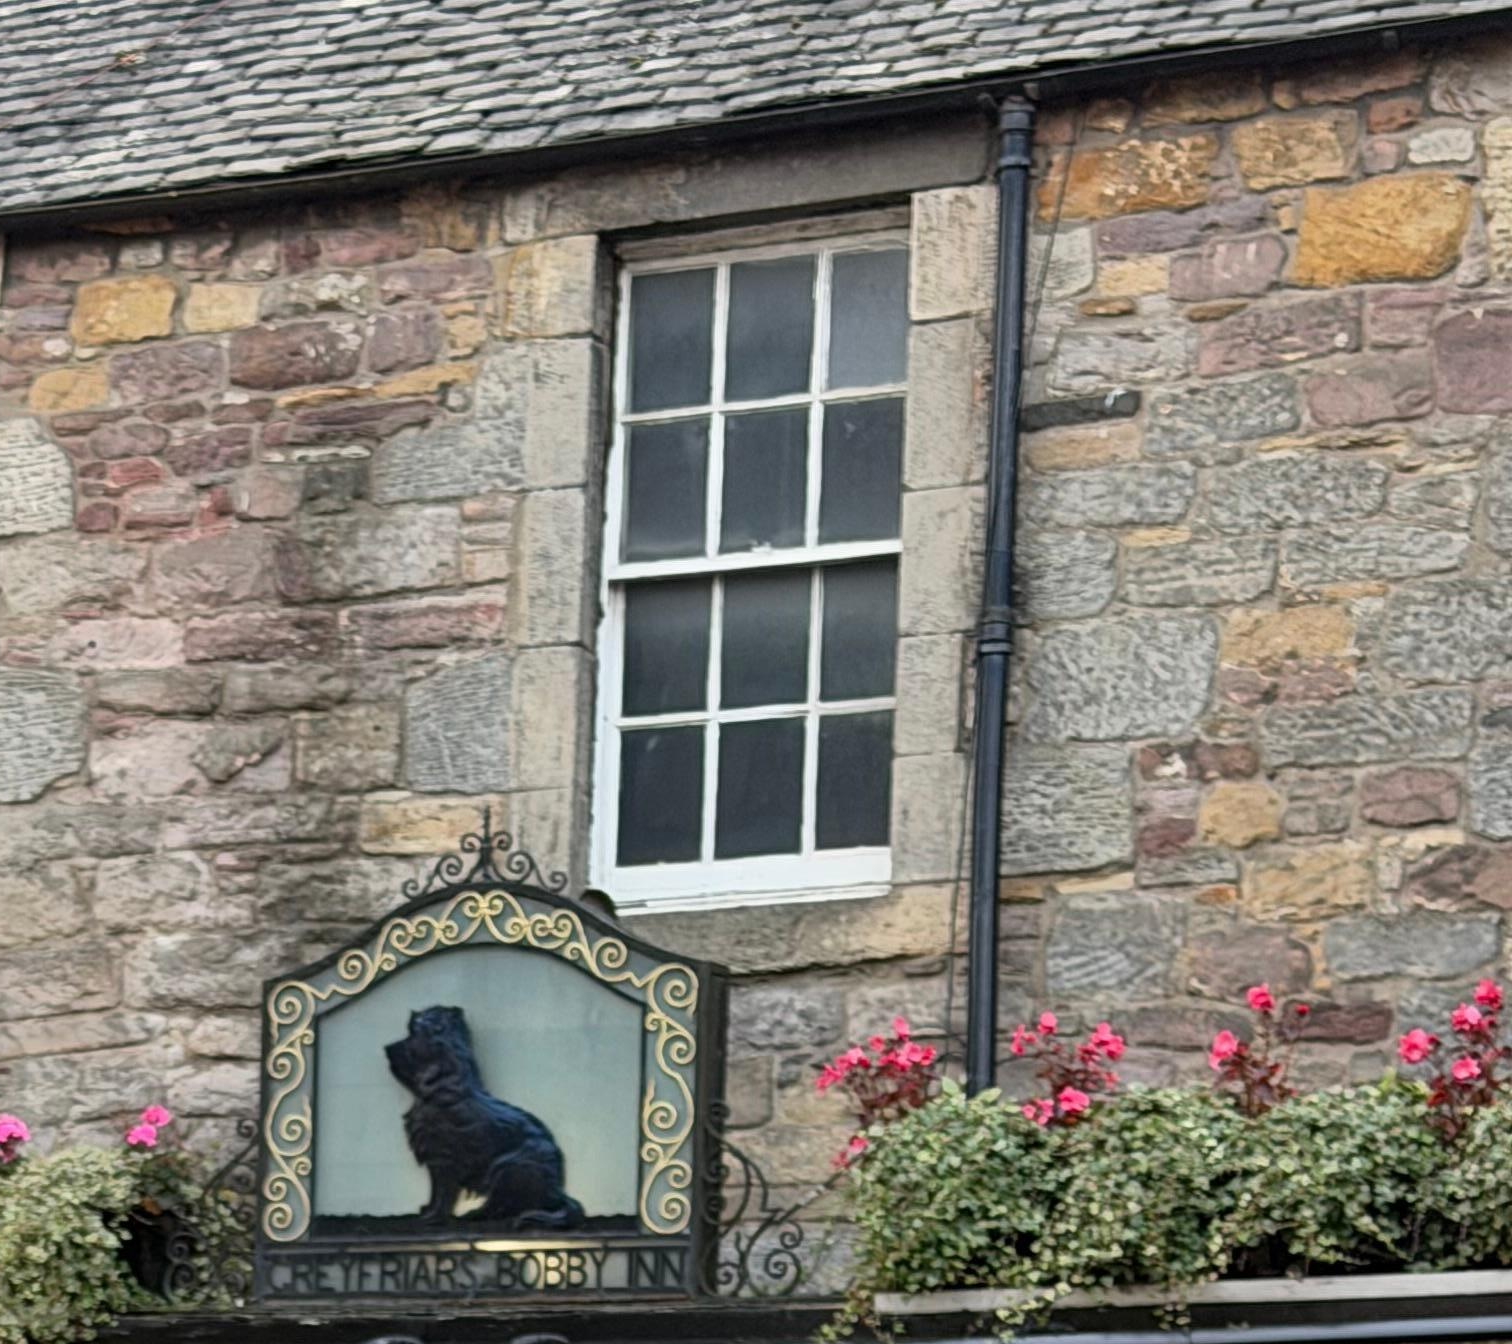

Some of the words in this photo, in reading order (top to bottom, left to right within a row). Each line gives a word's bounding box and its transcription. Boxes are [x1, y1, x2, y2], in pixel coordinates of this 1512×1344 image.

[267, 1254, 478, 1293] GREYFRIARS
[495, 1250, 610, 1290] BOBBY
[628, 1250, 686, 1287] INN
